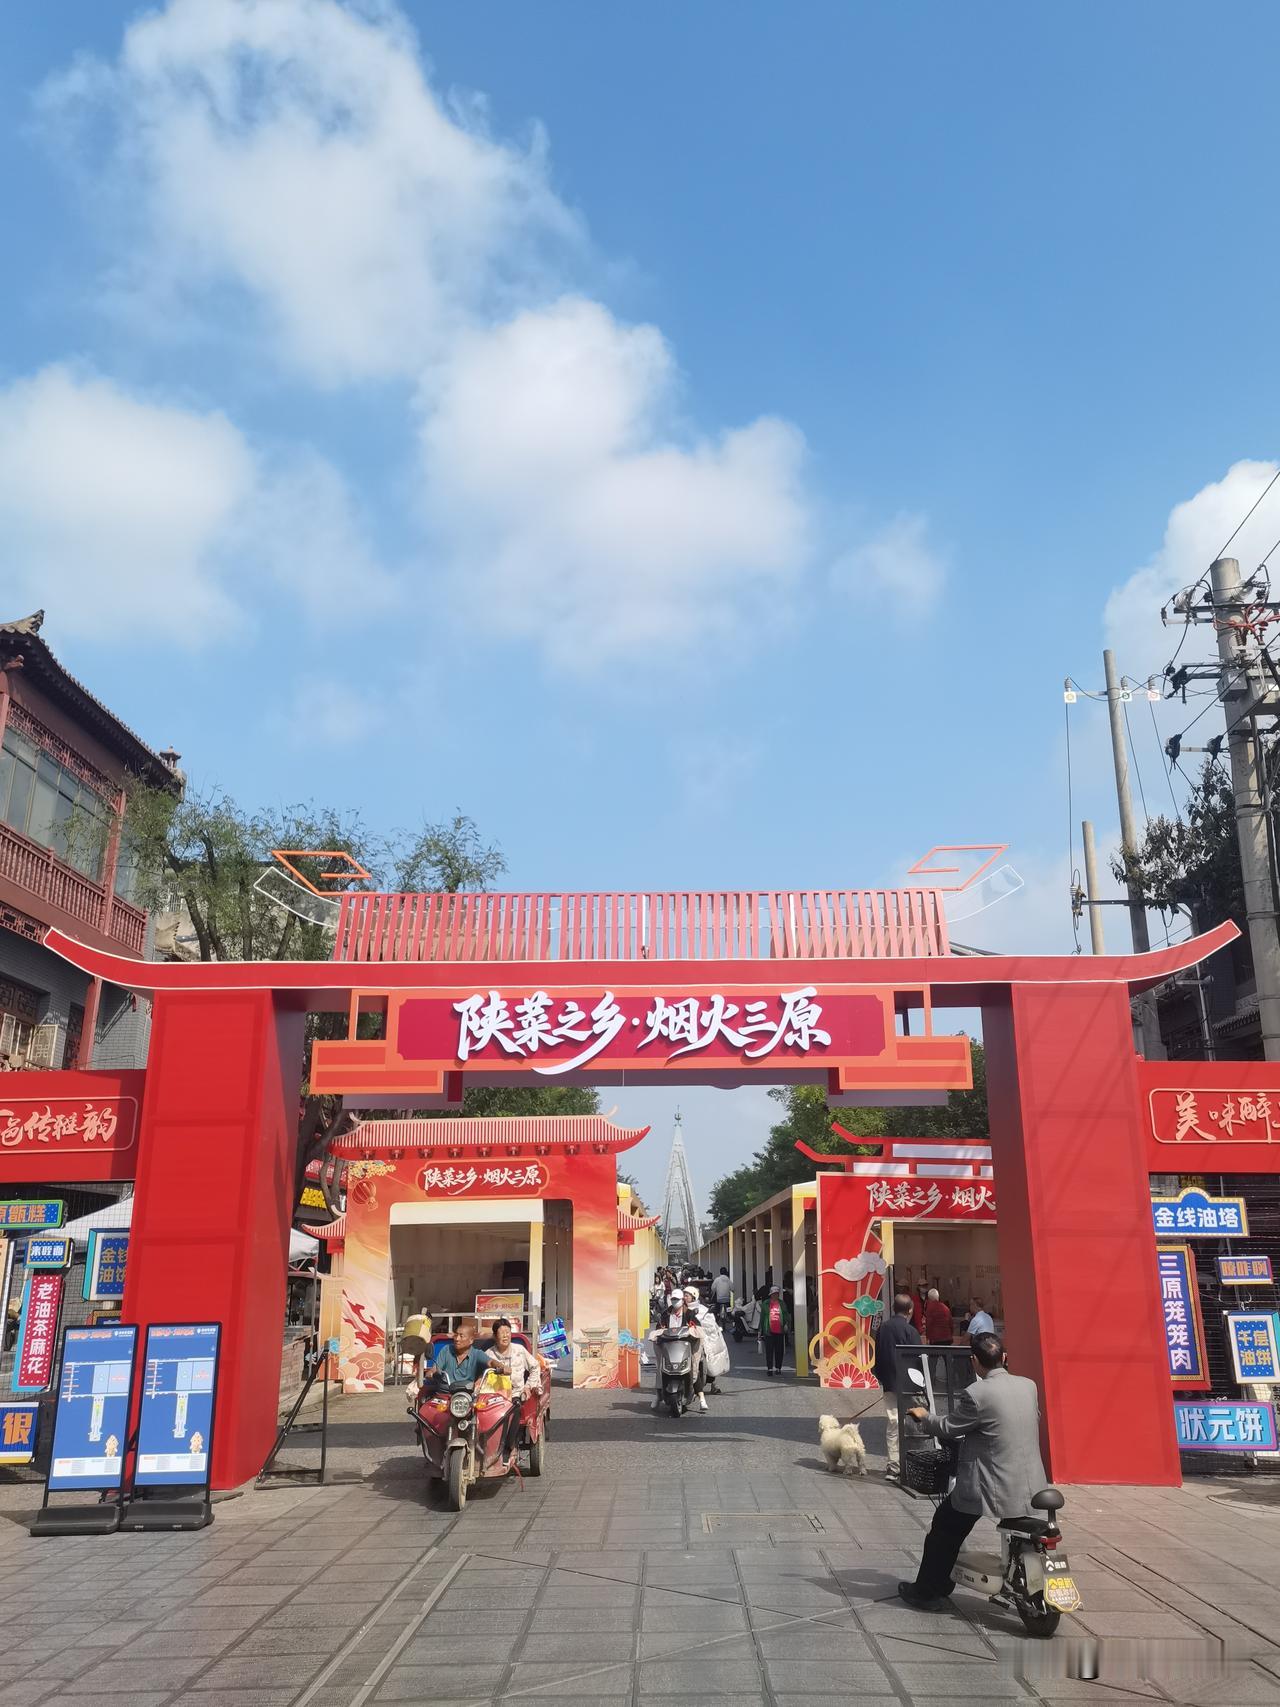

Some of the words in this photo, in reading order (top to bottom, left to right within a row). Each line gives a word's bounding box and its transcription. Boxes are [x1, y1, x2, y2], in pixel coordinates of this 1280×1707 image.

[453, 986, 832, 1076] 陕菜之乡·烟火三原
[0, 1103, 118, 1147] 色传雅韵
[1176, 1091, 1280, 1144] 美味醉
[423, 1164, 542, 1196] 陕菜之乡·烟火三原
[1154, 1206, 1239, 1228] 金线油塔
[27, 1282, 53, 1375] 老油茶麻花
[1159, 1255, 1192, 1370] 三原笼笼肉
[1238, 1330, 1269, 1346] 千层
[1241, 1350, 1271, 1366] 油饼
[1178, 1407, 1263, 1441] 状元饼
